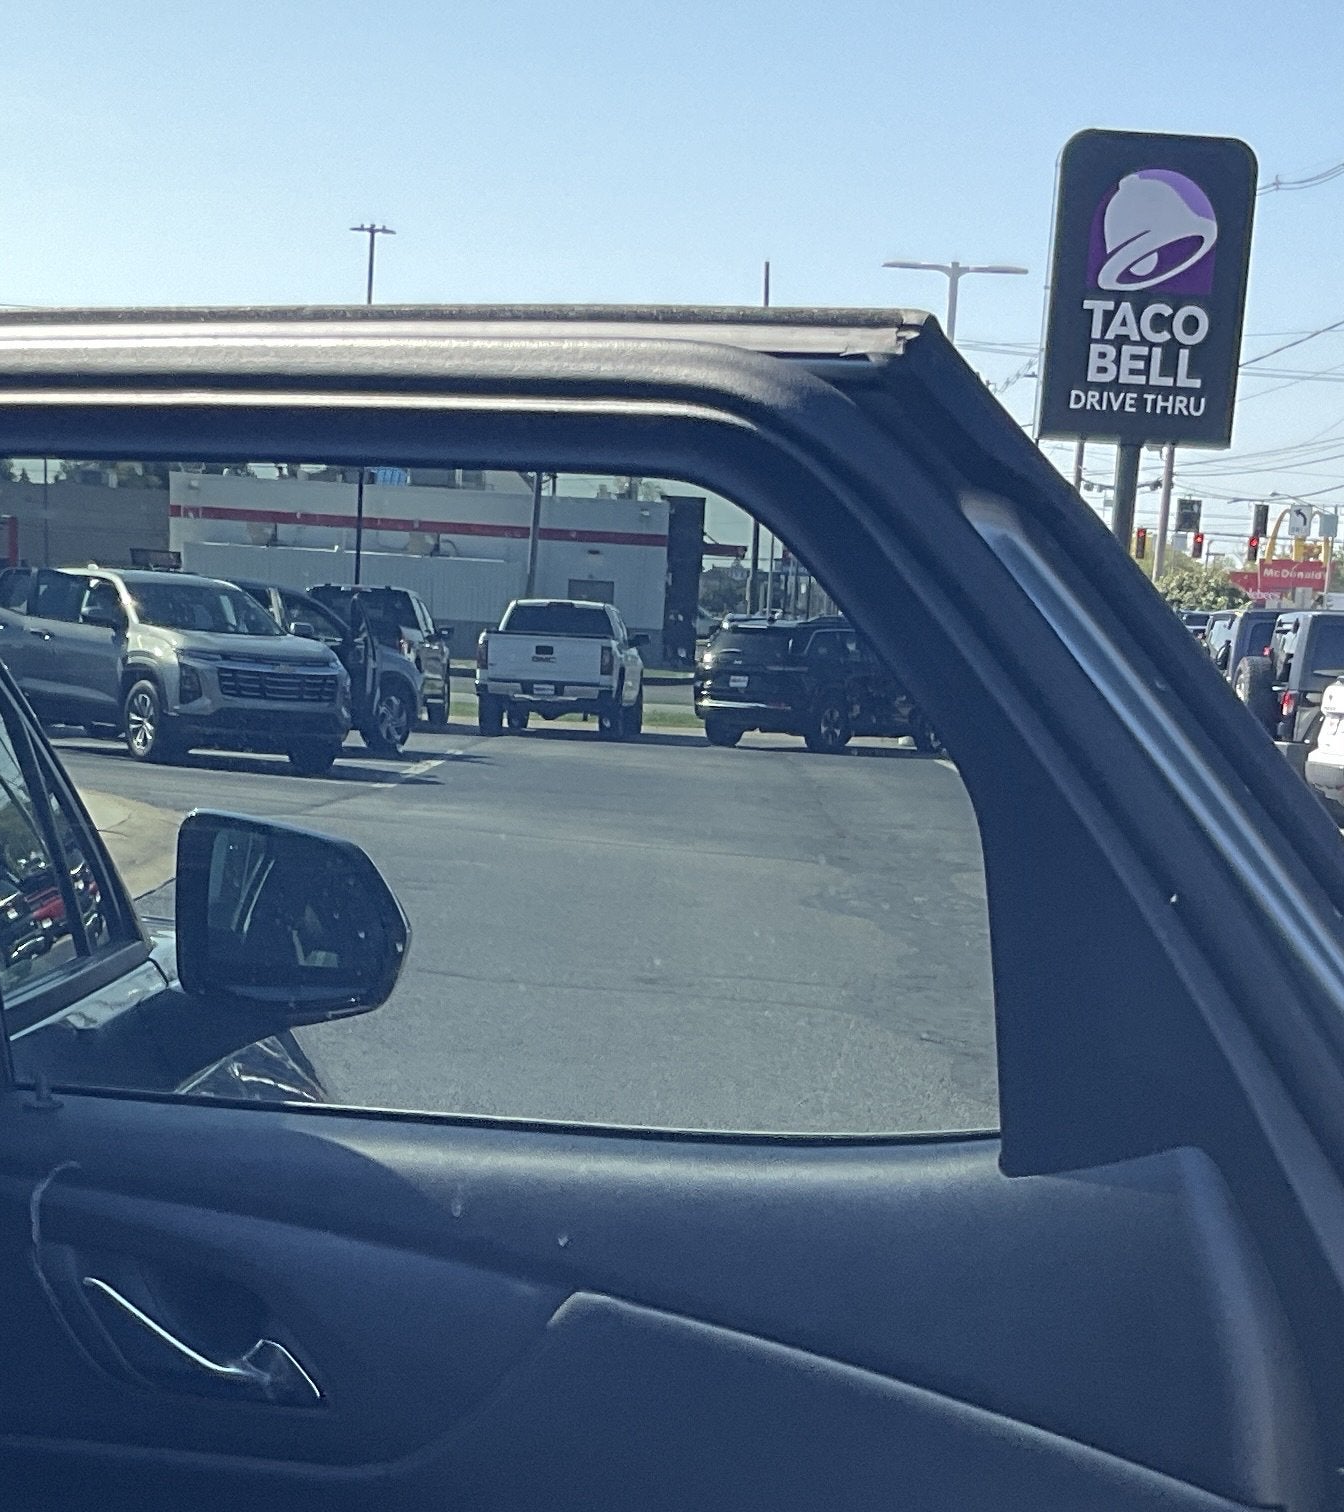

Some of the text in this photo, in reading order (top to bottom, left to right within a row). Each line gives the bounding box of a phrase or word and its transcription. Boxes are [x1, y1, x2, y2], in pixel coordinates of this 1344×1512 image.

[1083, 299, 1209, 345] TACO
[1087, 343, 1202, 389] BELL
[1069, 389, 1206, 417] DRIVE THRU
[531, 656, 557, 664] GMC
